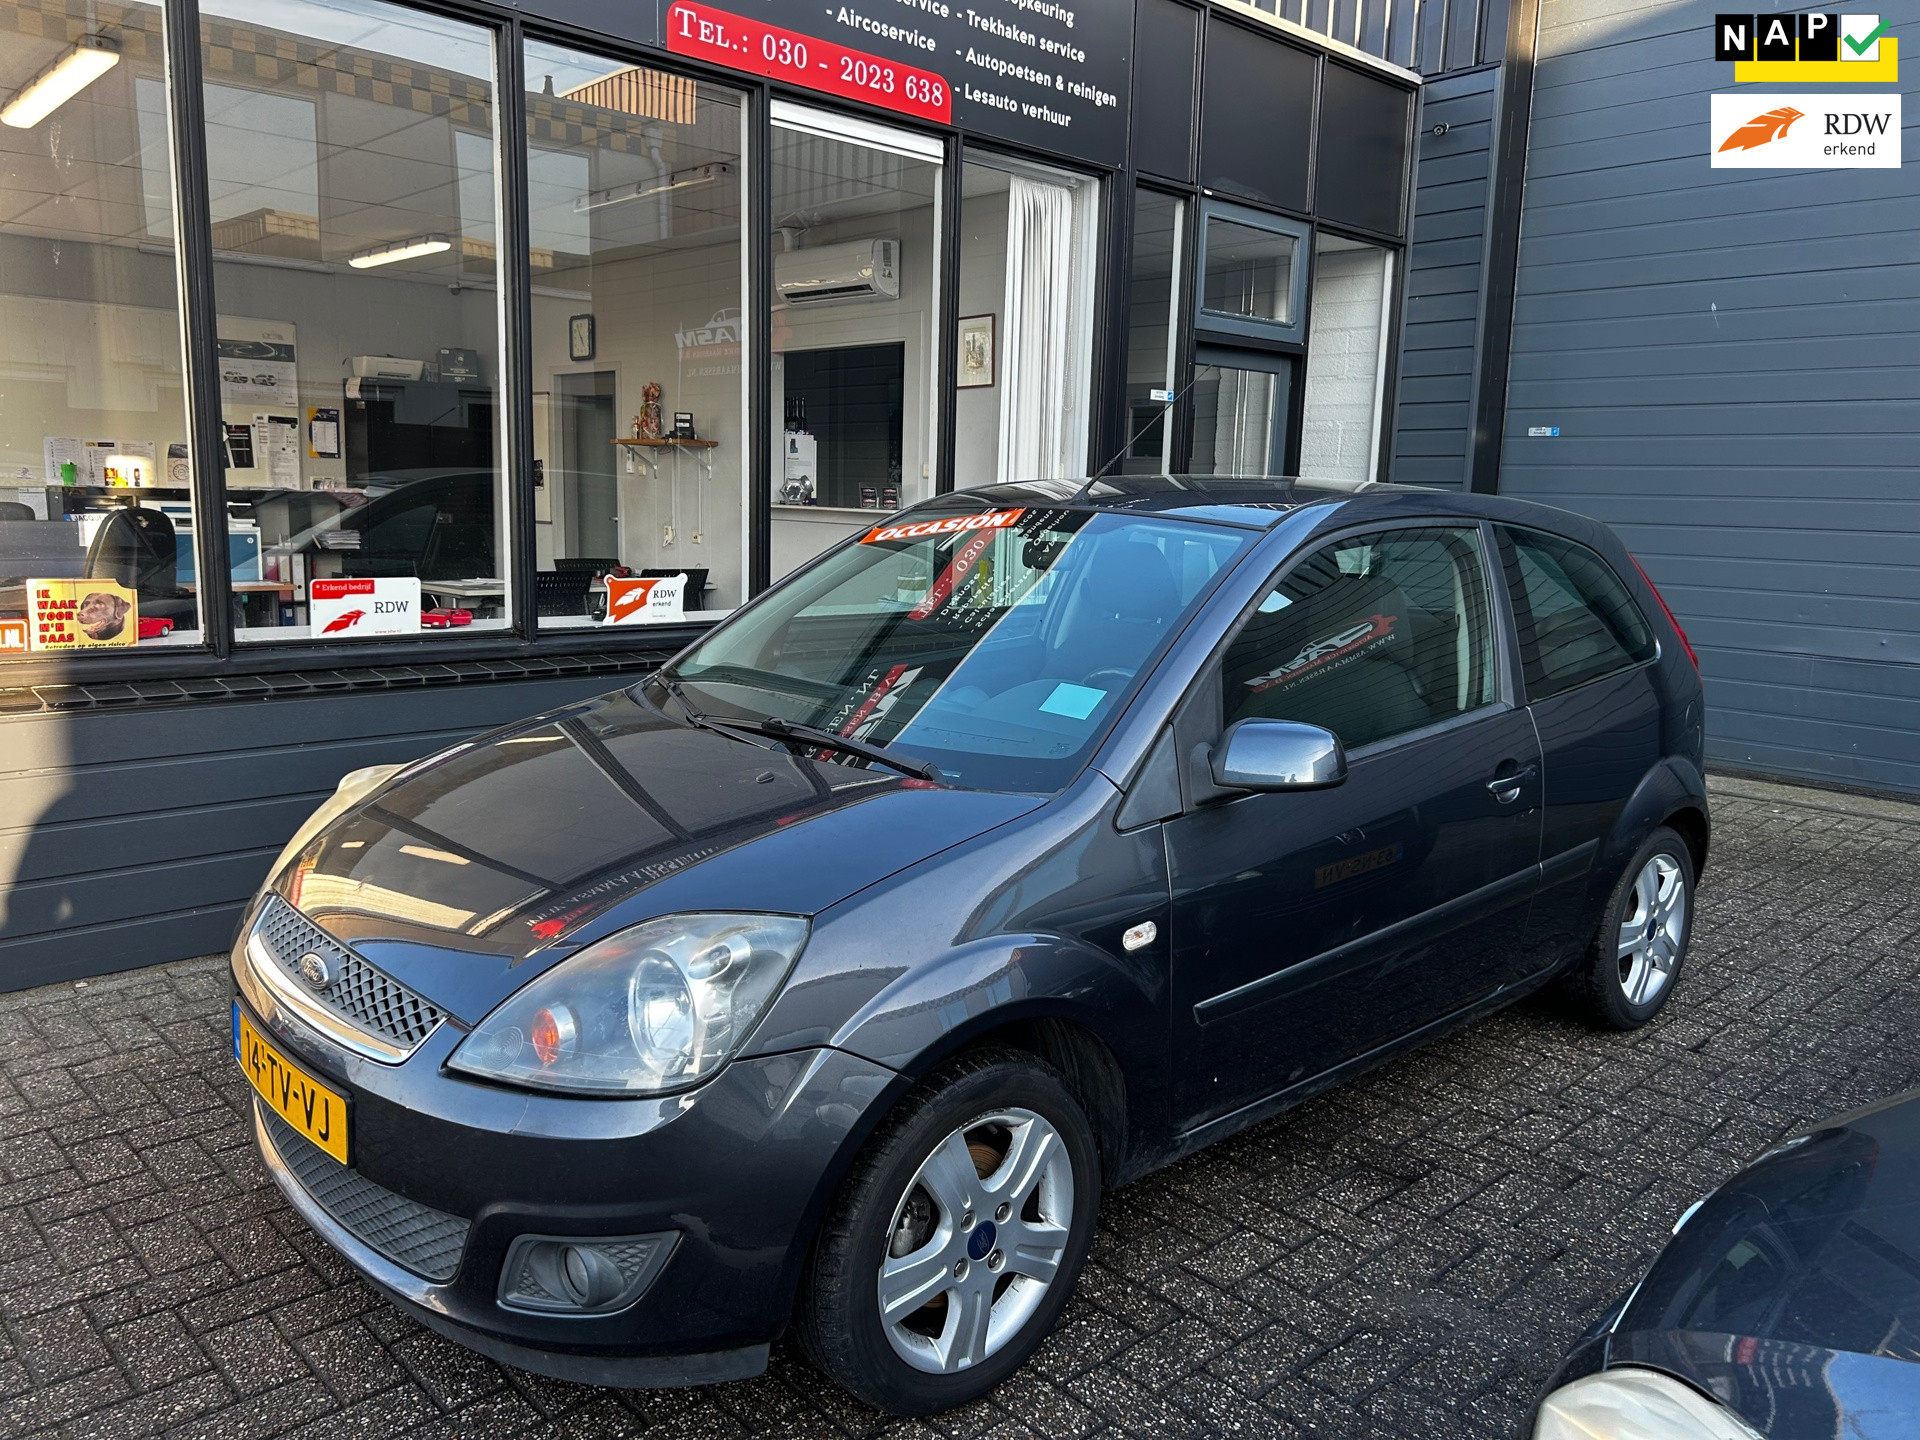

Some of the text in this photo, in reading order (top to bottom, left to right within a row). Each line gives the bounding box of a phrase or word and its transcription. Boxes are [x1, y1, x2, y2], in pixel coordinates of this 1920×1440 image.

[1004, 0, 1074, 28] pkeuring
[837, 6, 936, 51] Aircoservice
[966, 9, 1036, 47] Trekhaken
[1039, 37, 1086, 63] service
[762, 34, 807, 69] 030
[840, 56, 895, 93] 2023
[905, 75, 943, 107] 638
[965, 47, 1051, 87] Autopoetsen
[1055, 75, 1064, 91] &
[1067, 81, 1117, 107] reinigen
[965, 83, 1018, 112] Lesauto
[1022, 102, 1071, 127] verhuur
[36, 589, 51, 599] IK
[321, 582, 372, 592] Erkend bedrijf
[653, 589, 677, 599] RDW
[37, 600, 78, 610] WAAK
[374, 601, 409, 614] RDW
[37, 611, 74, 621] VOOR
[0, 628, 24, 648] .NL
[39, 633, 75, 644] BAAS
[246, 1029, 330, 1142] 14-TV-VJ
